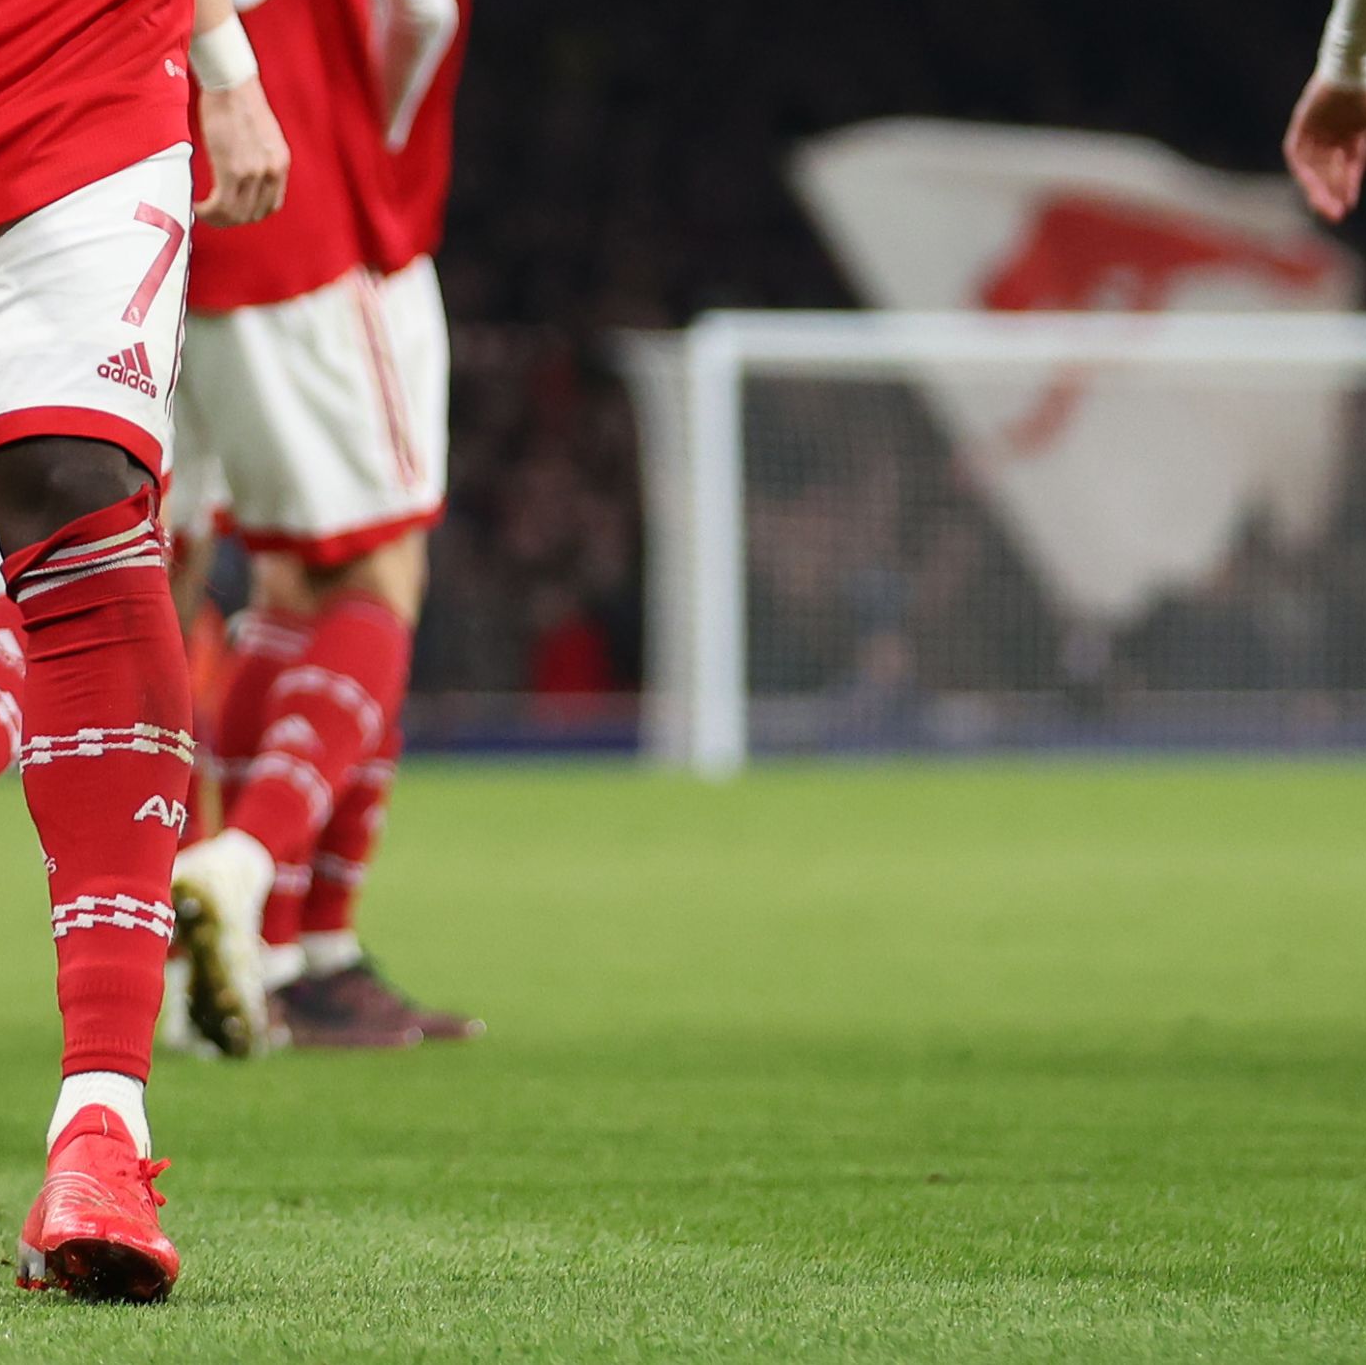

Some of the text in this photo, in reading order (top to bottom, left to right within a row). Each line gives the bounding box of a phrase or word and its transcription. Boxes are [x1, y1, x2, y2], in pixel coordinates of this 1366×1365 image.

[121, 201, 186, 328] 7
[96, 362, 158, 399] adidas
[133, 794, 188, 839] AF
